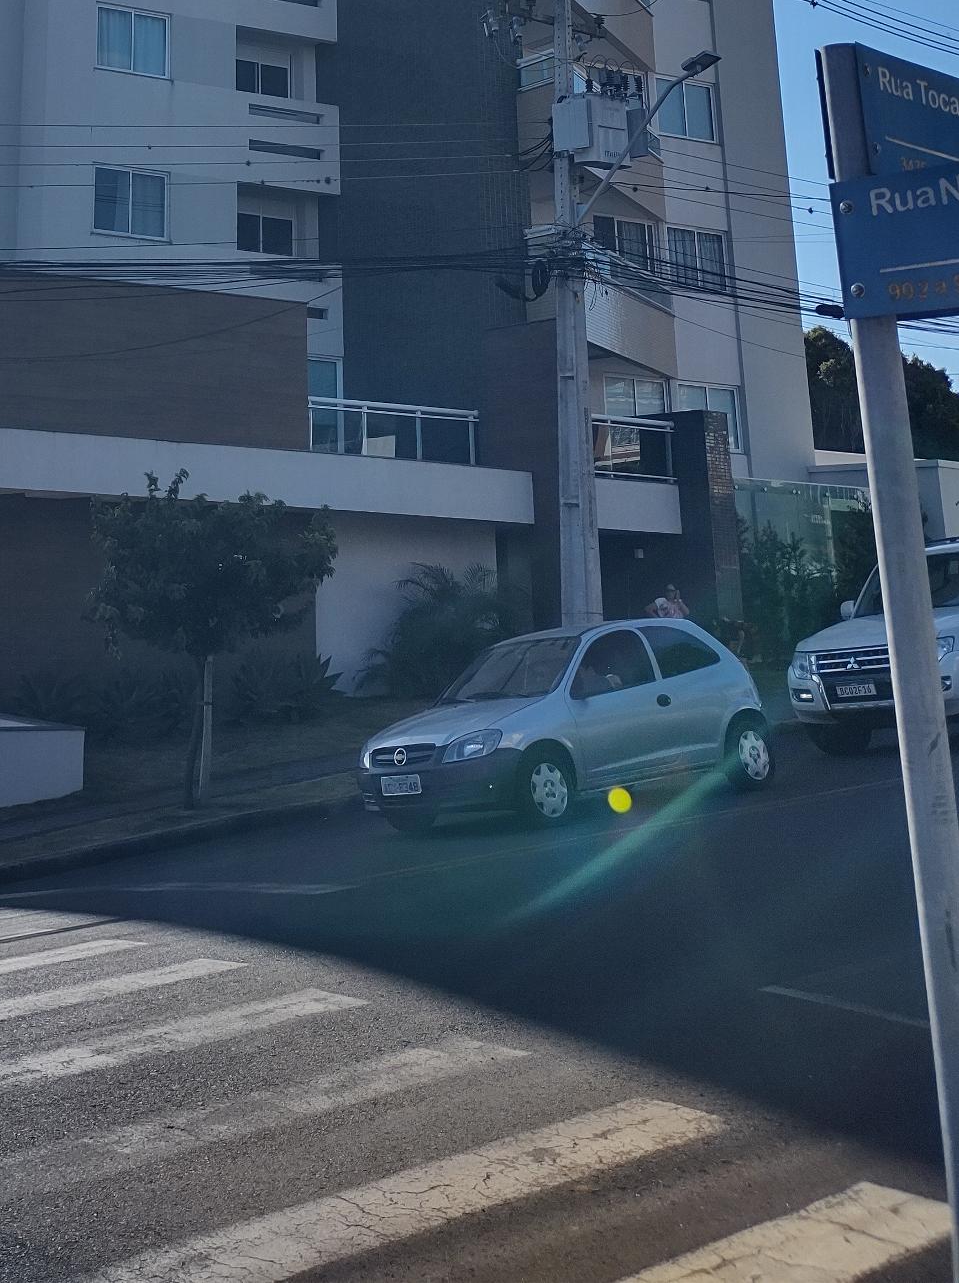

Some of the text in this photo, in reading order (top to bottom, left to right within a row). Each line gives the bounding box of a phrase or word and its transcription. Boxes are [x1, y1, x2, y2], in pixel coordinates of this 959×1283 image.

[877, 66, 959, 116] Rua Toca
[869, 185, 936, 216] Rua
